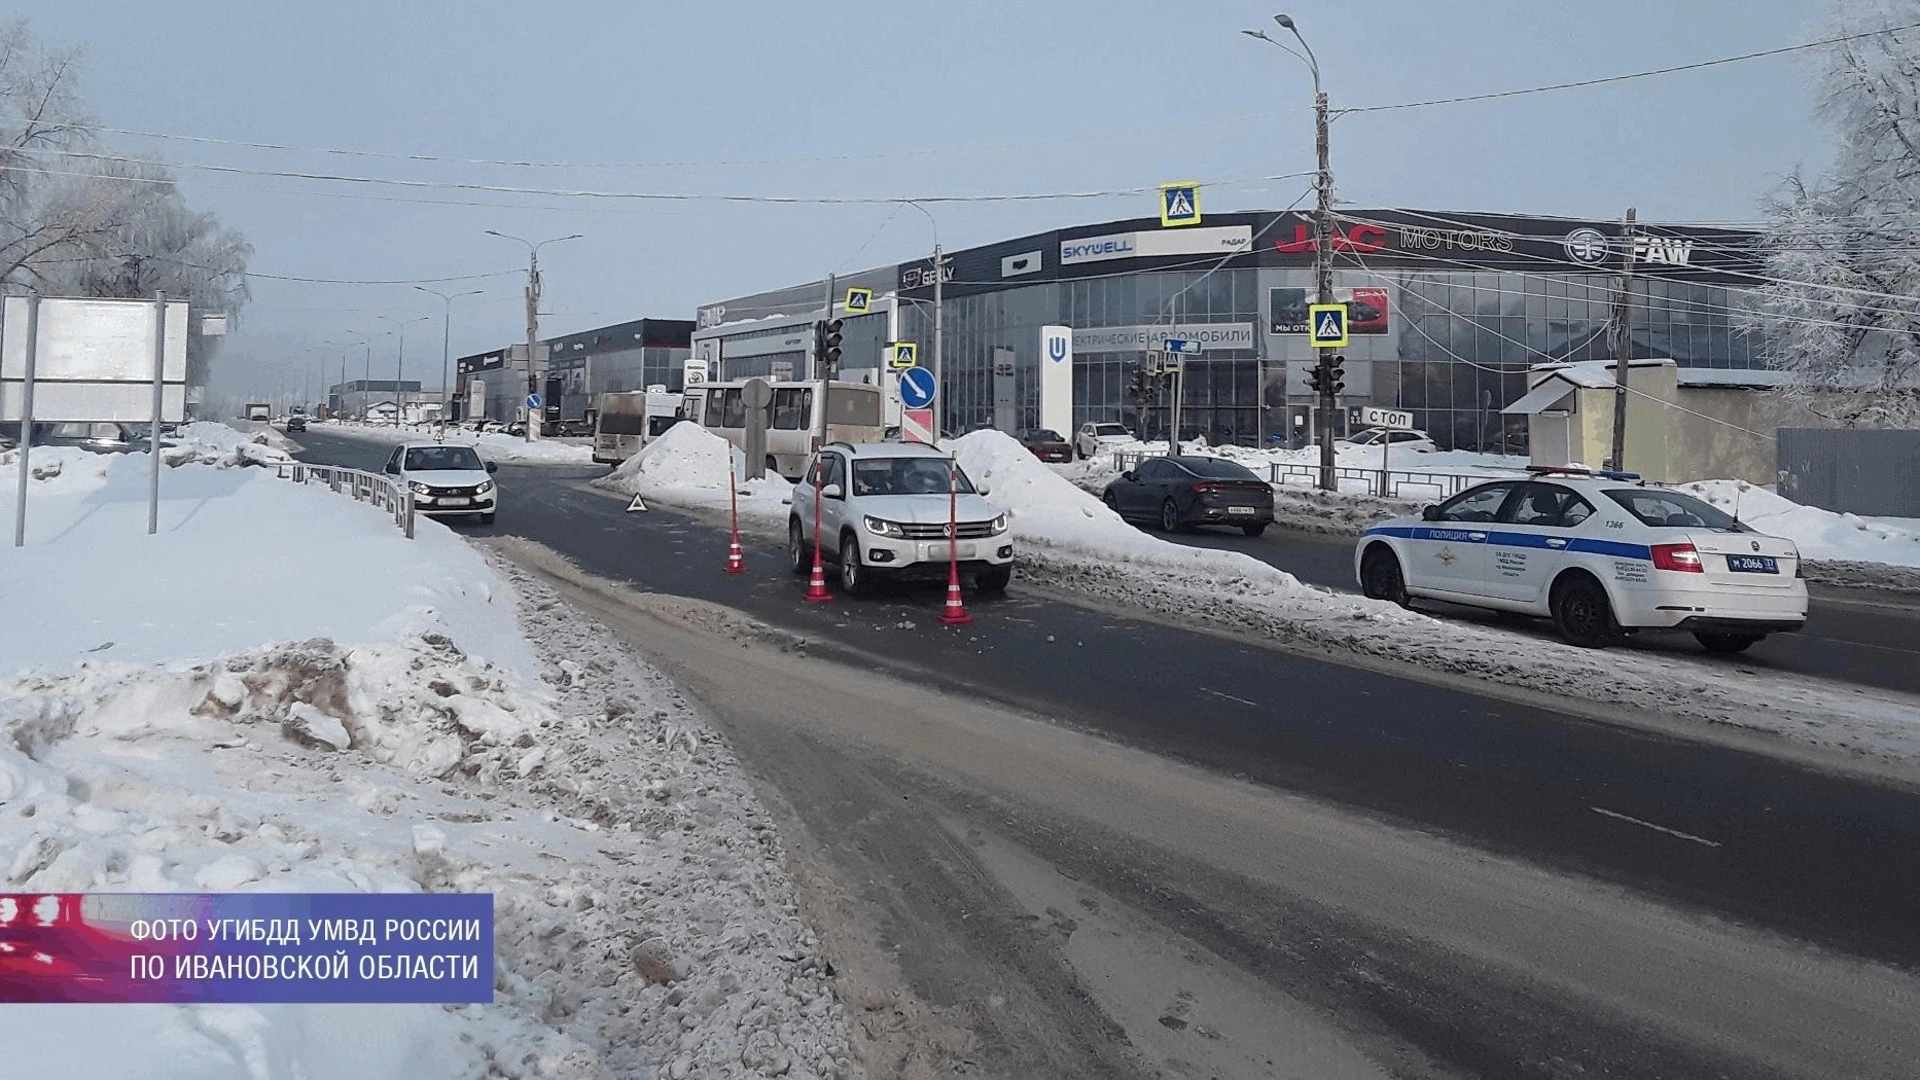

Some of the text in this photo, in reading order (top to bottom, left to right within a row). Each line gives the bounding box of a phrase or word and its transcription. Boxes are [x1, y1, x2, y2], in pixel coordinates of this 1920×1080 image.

[1221, 238, 1247, 246] РАДАР
[1400, 227, 1513, 252] MOTORS
[1063, 240, 1133, 258] SKYWELL
[1632, 237, 1694, 265] FAW
[922, 266, 955, 285] GELY
[1276, 324, 1310, 333] МЫ ОТК
[1369, 410, 1406, 426] СТОП
[1605, 520, 1624, 529] 1366
[1429, 530, 1468, 541] ПОЛИЦИЯ
[1742, 558, 1763, 569] 2066
